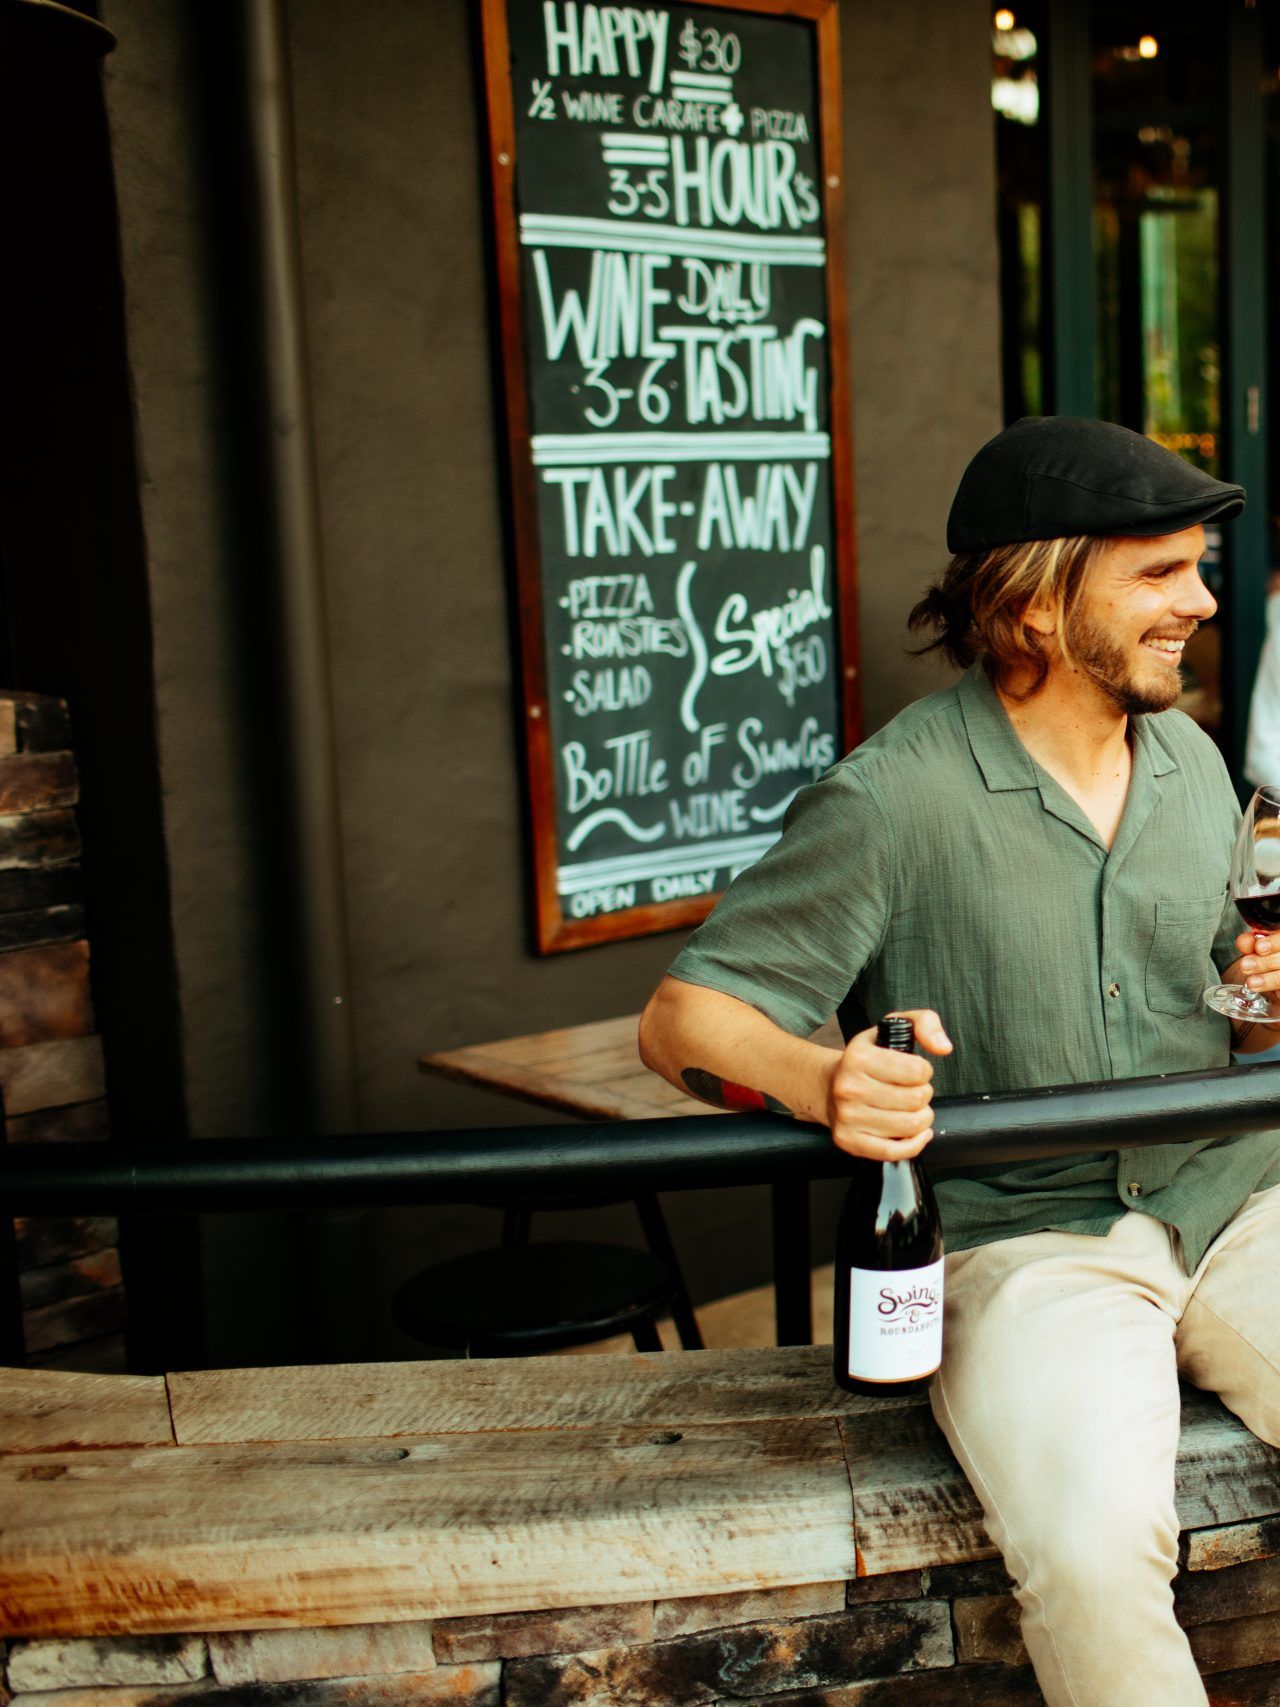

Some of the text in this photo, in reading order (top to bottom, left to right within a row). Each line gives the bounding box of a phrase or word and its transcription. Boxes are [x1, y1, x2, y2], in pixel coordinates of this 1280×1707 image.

[543, 1, 742, 94] HAPPY $30
[562, 90, 626, 124] WINE
[633, 95, 721, 134] CARAFE
[751, 107, 810, 144] PIZZA
[607, 169, 670, 219] 3-5
[533, 249, 677, 366] WINE
[584, 318, 825, 433] 3-6 TASTING
[542, 462, 818, 557] TAKE-AWAY
[711, 544, 833, 678] Special
[776, 633, 827, 708] $50
[669, 788, 750, 840] WINE
[570, 884, 636, 919] OPEN
[651, 866, 718, 902] DAILY
